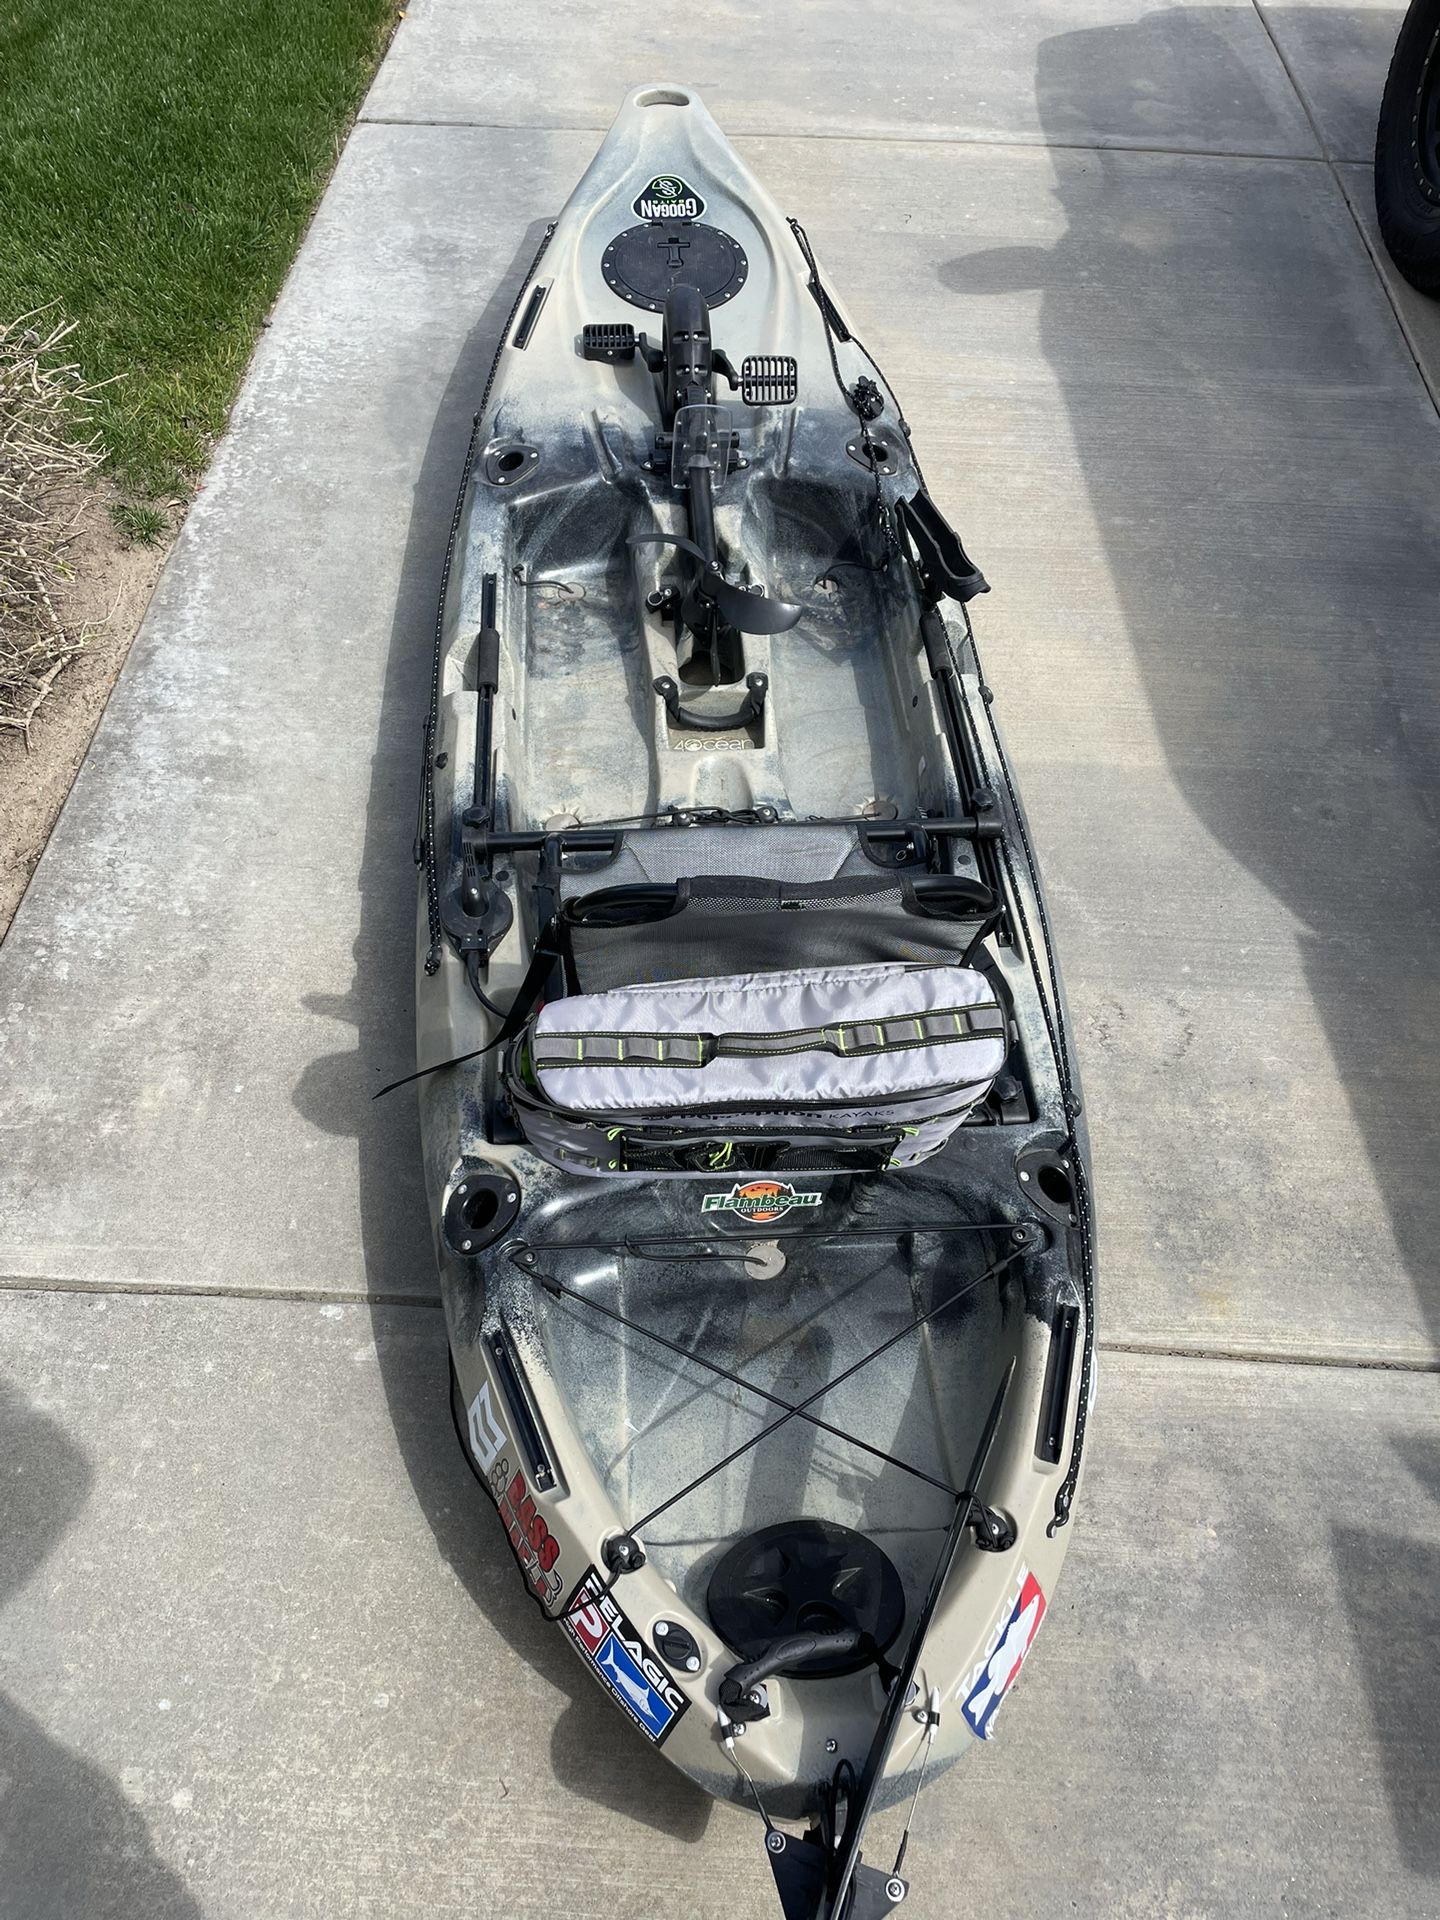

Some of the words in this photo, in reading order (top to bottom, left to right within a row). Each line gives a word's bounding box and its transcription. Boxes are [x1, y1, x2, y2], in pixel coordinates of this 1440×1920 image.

[641, 198, 697, 217] GOOGAN
[829, 1110, 895, 1120] KAYAKS
[704, 1194, 819, 1210] Flambeau
[506, 1469, 560, 1573] BASS
[585, 1572, 684, 1712] PELAGIC
[955, 1560, 1030, 1700] TACKLE
[574, 1633, 612, 1689] Performance
[611, 1687, 640, 1726] Offshore
[638, 1723, 657, 1744] Gear
